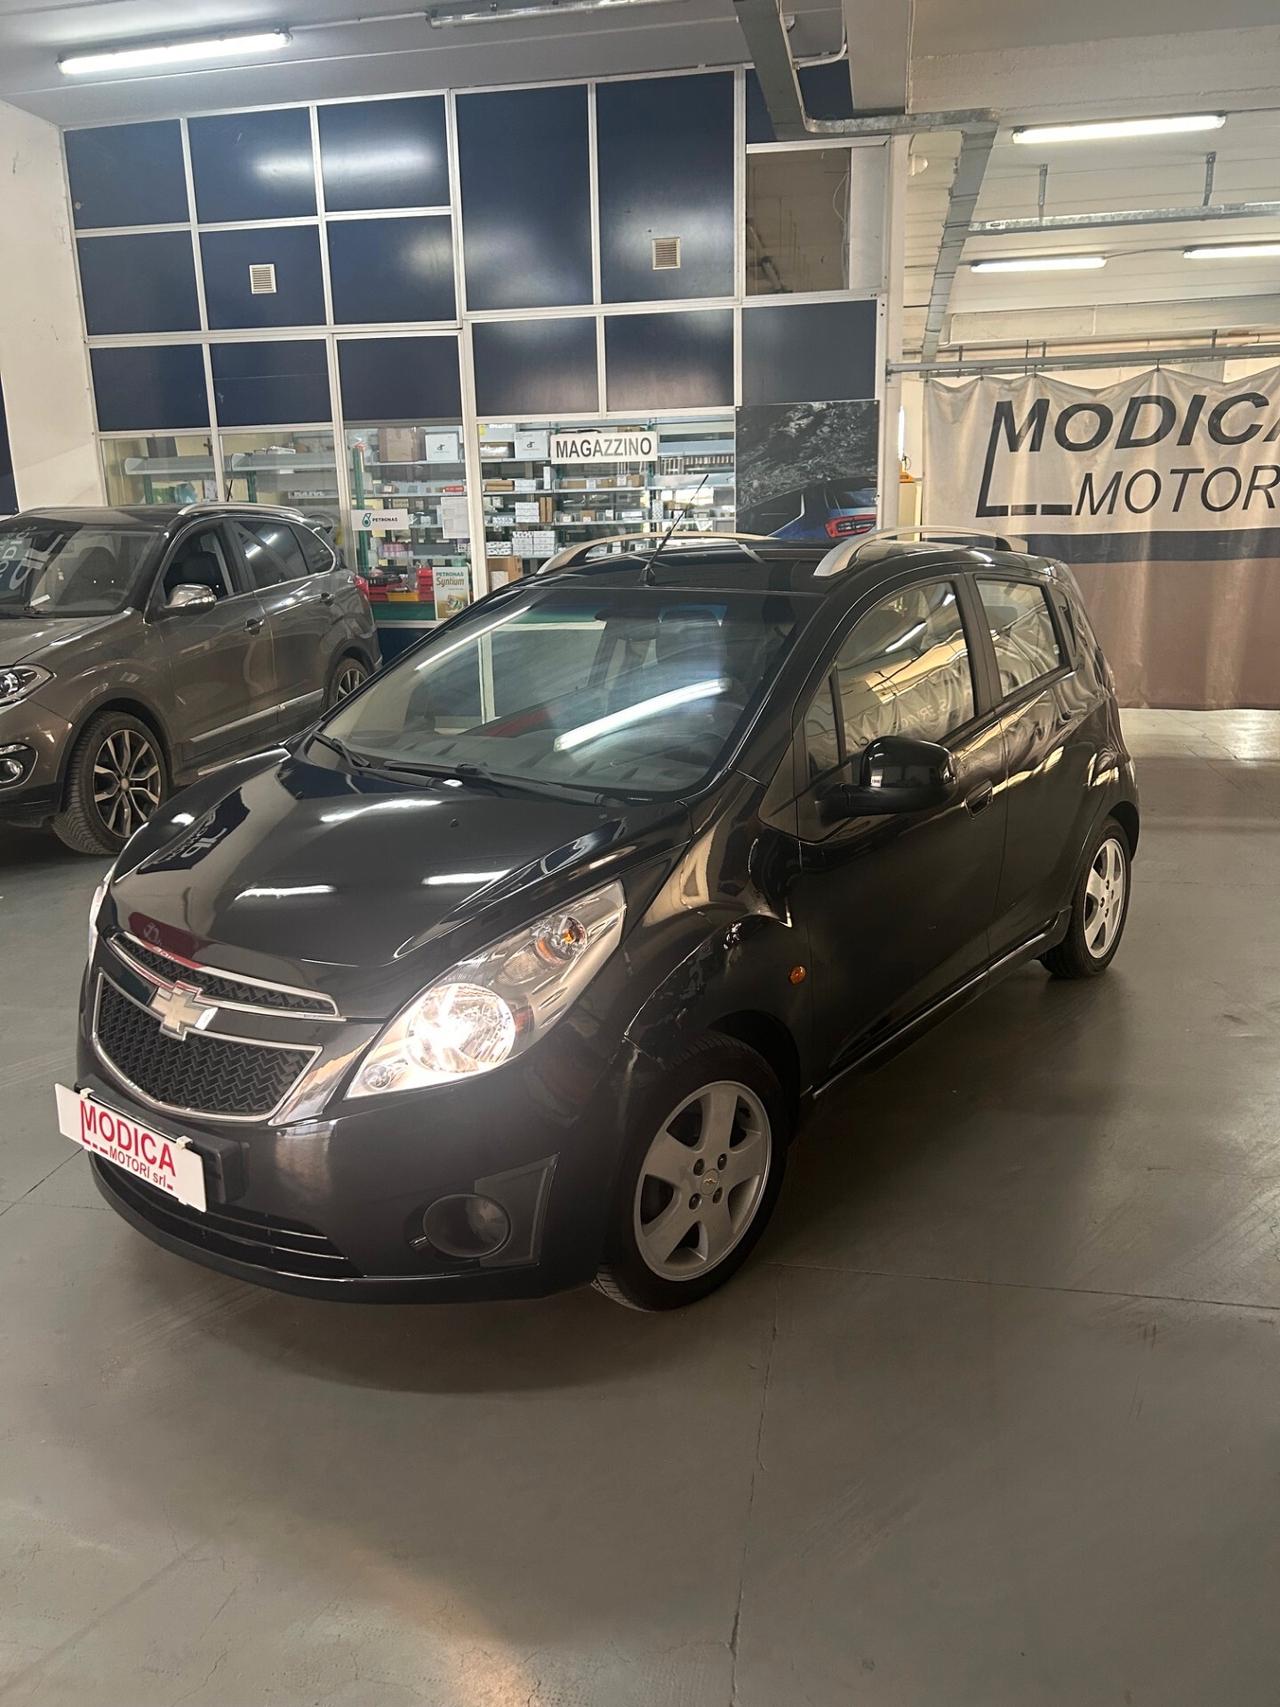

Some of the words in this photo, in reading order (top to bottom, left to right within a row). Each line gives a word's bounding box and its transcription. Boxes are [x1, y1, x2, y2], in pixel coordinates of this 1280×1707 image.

[555, 436, 652, 458] MAGAZZINO
[1075, 465, 1280, 516] MOTOR
[436, 577, 465, 588] Syntium
[80, 1101, 176, 1177] MODICA
[109, 1145, 150, 1179] MOTORI
[153, 1171, 167, 1188] srl
